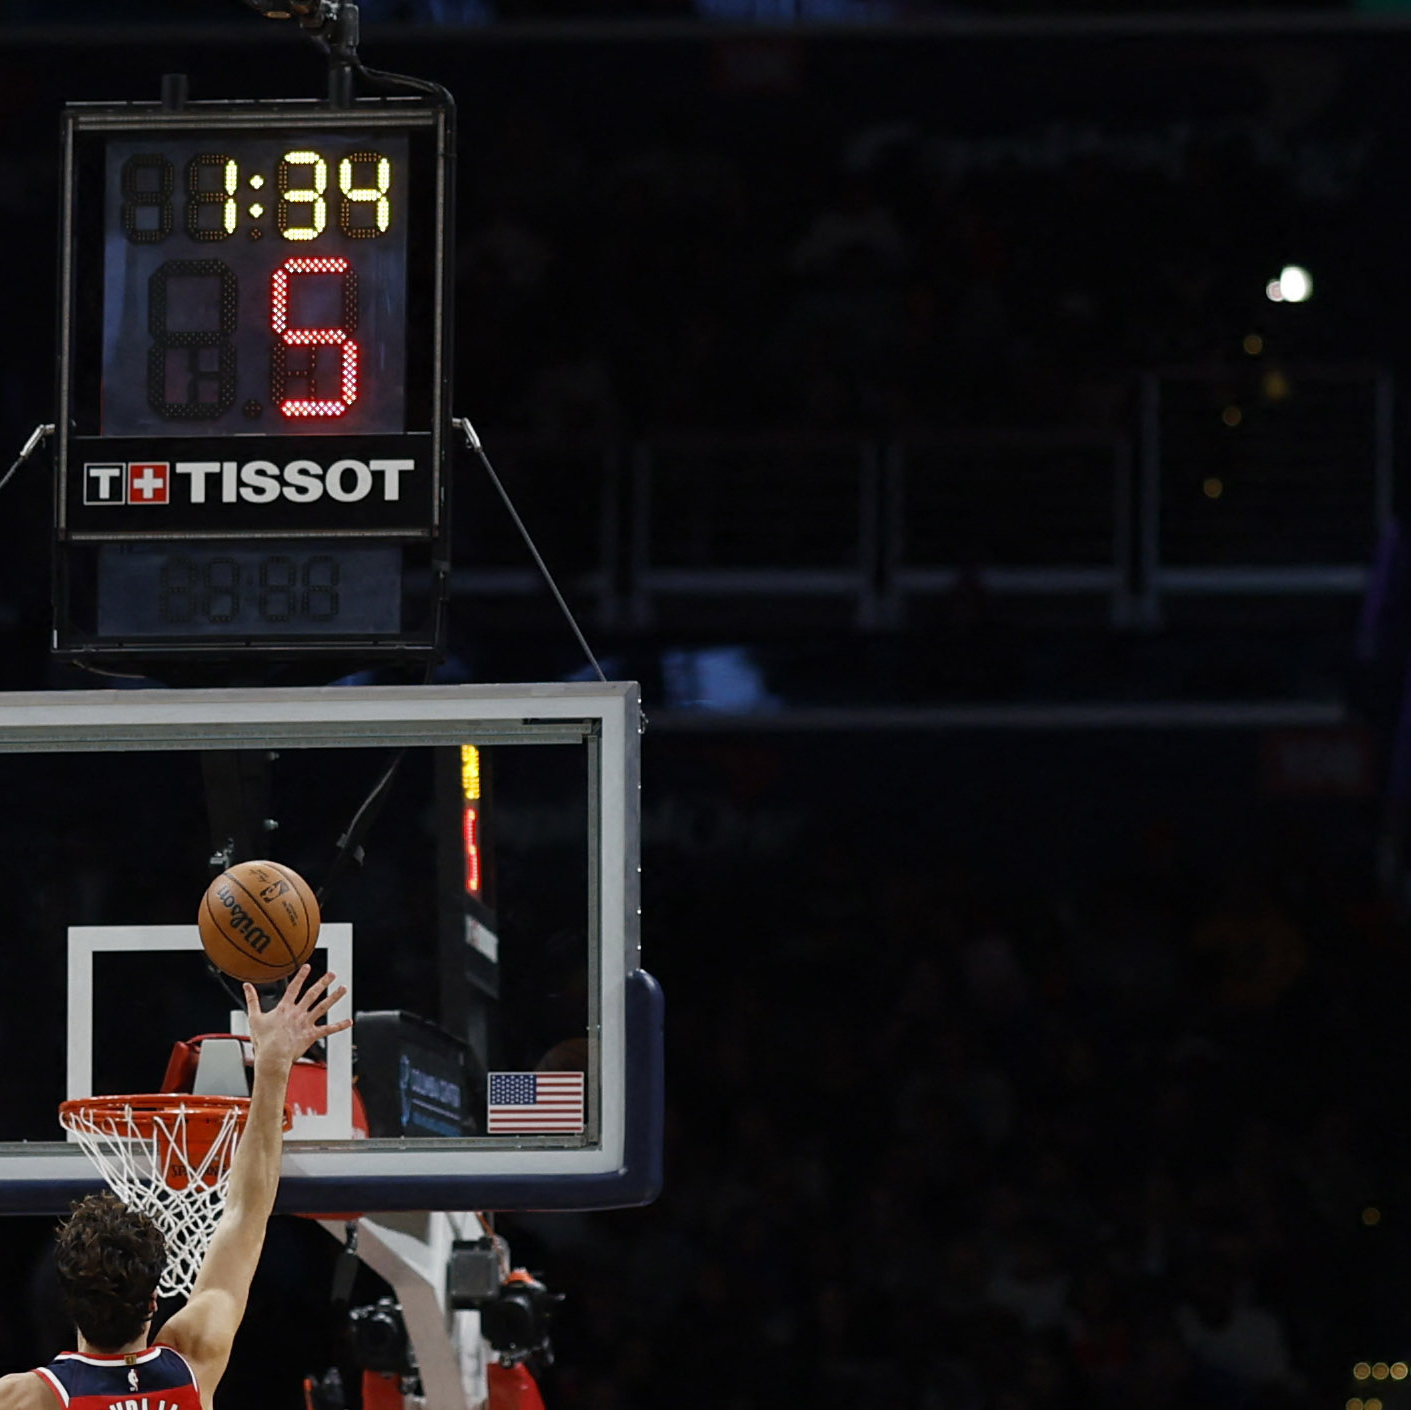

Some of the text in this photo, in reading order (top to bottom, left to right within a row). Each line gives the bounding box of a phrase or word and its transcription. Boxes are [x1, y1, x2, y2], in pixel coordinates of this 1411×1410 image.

[224, 151, 390, 241] 1:34
[271, 256, 358, 417] 5
[175, 459, 415, 503] TISSOT
[217, 883, 273, 955] Wilson
